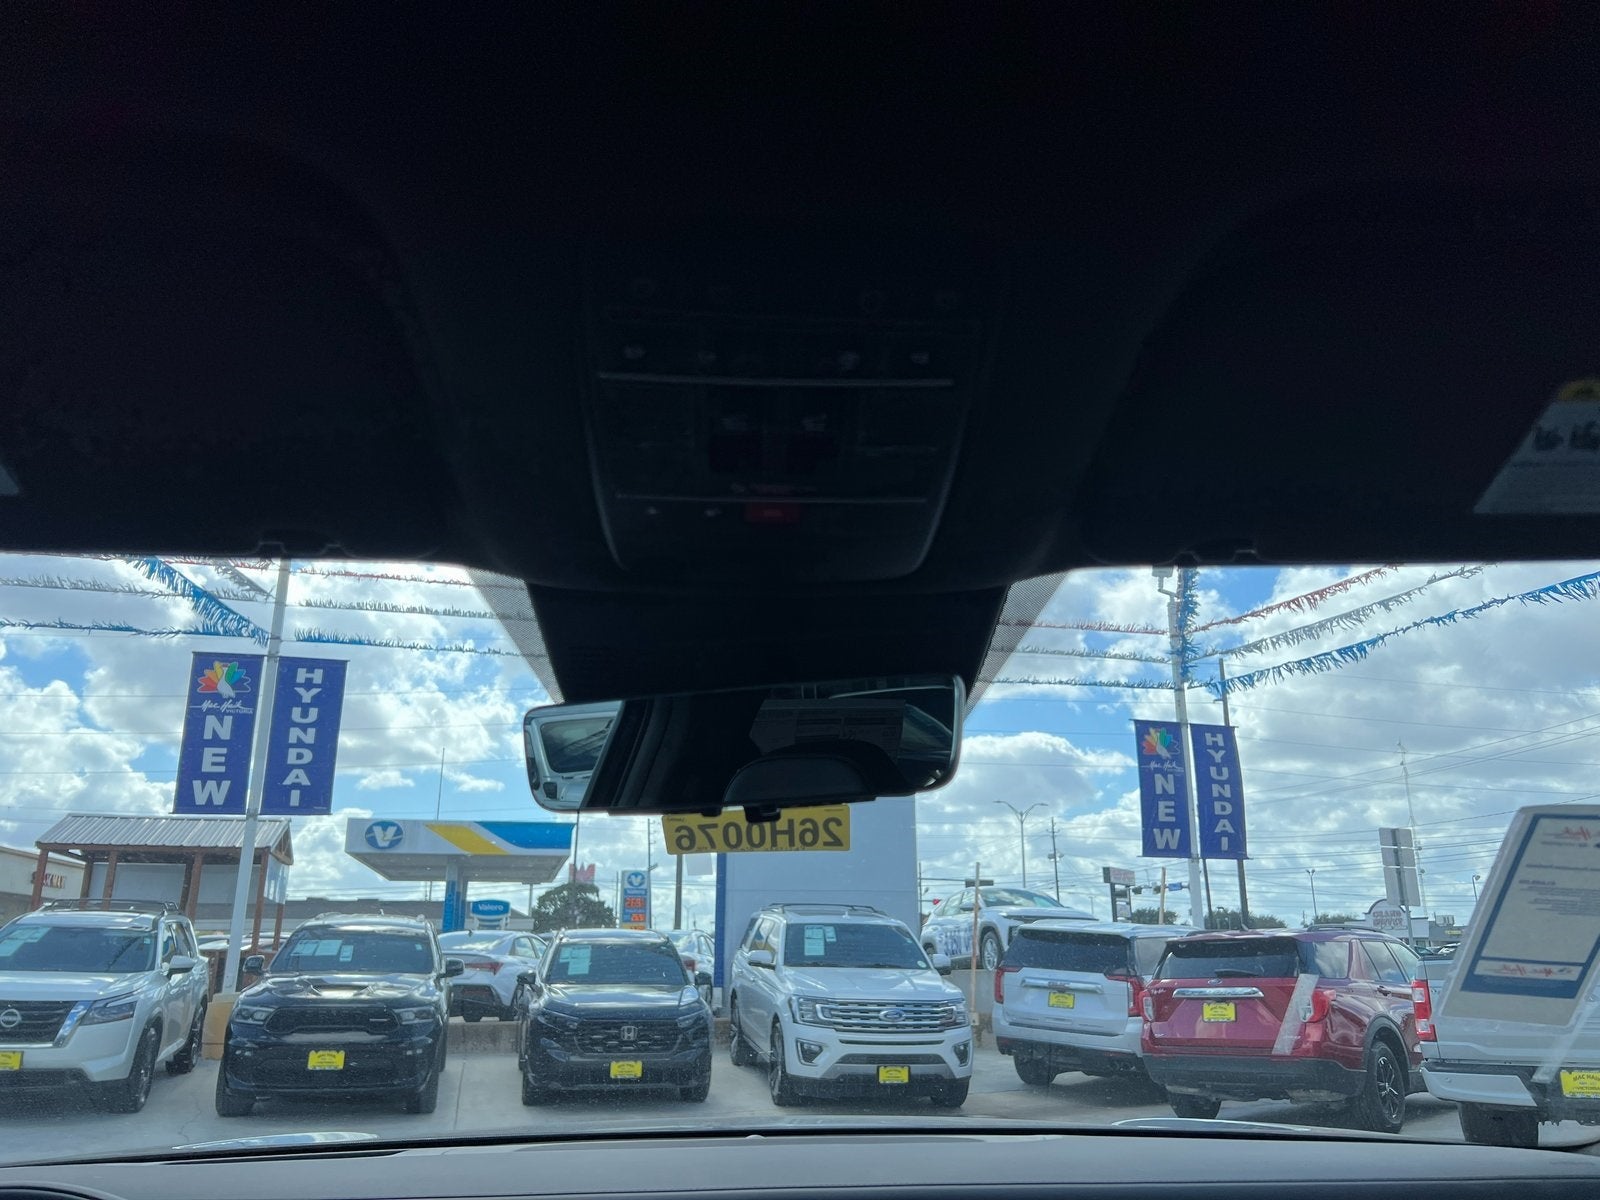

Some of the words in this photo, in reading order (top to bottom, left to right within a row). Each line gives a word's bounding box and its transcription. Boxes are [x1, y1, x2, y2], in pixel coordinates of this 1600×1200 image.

[192, 714, 233, 806] NEW
[281, 667, 324, 807] HYUNDAI
[1152, 773, 1181, 850] NEW
[1204, 732, 1235, 852] HYUNDAI
[478, 903, 504, 912] Valero
